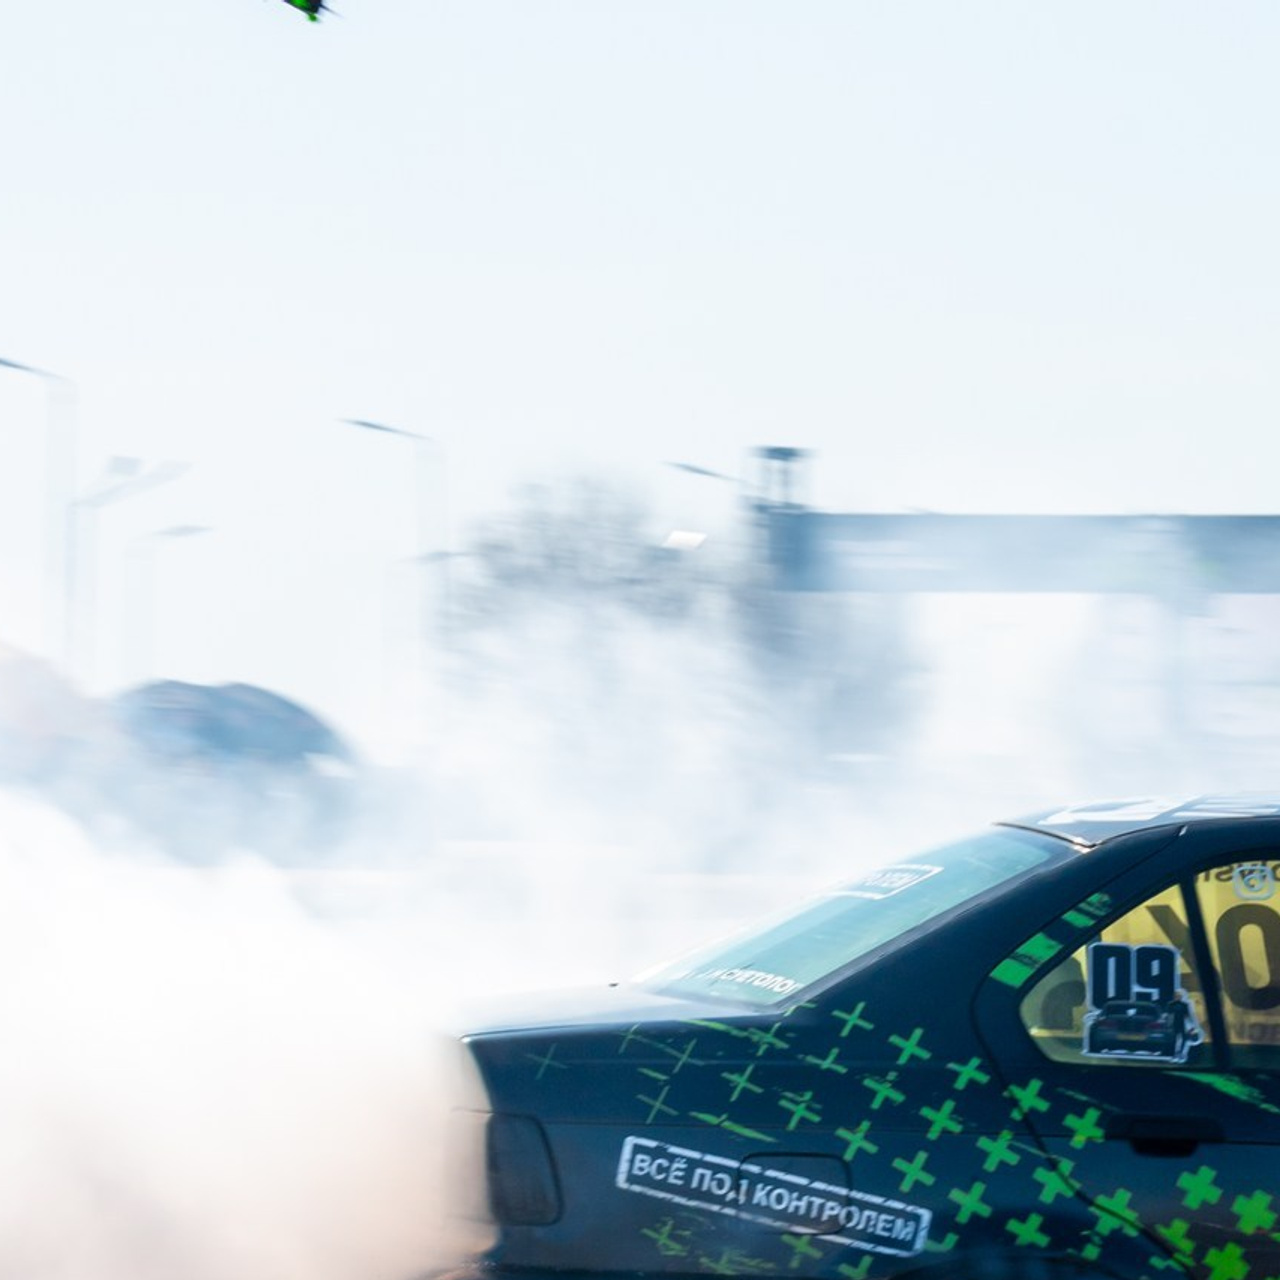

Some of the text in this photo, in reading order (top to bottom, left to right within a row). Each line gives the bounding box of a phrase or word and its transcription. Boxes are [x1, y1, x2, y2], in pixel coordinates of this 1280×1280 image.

[1090, 944, 1178, 1009] 09
[631, 1153, 917, 1242] ВСЁ ПОД КОНТРОЛЕМ
